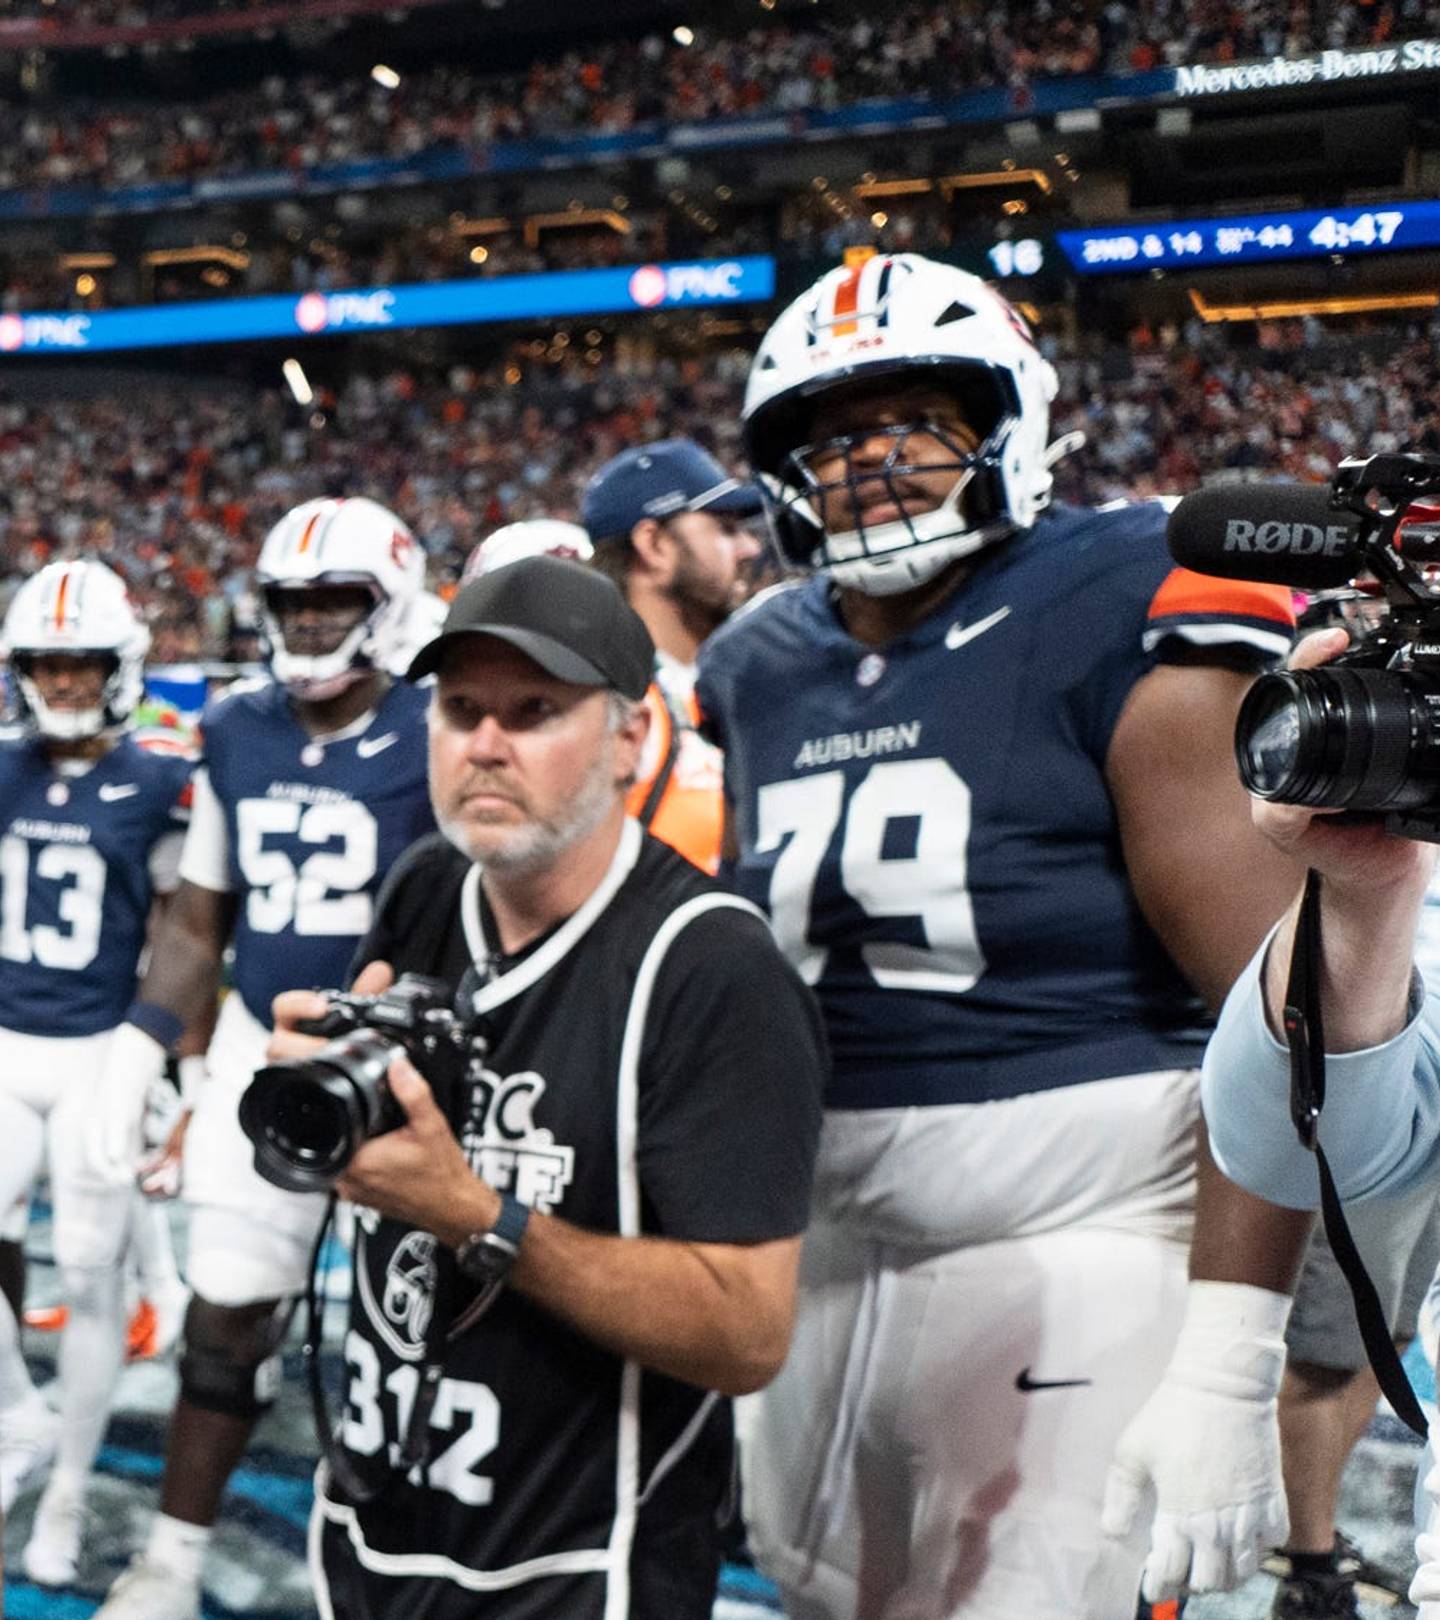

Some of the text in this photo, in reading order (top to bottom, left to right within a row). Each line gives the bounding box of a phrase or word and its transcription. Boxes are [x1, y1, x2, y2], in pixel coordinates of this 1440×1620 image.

[1175, 47, 1397, 96] Mercedes-Benz
[988, 239, 1044, 277] 16
[1082, 235, 1138, 263] 2ND
[1169, 231, 1203, 255] 14
[1309, 211, 1404, 249] 4:47
[1223, 519, 1347, 557] RØDE
[795, 721, 921, 769] AUBURN
[236, 797, 378, 935] 52
[756, 757, 987, 993] 79
[343, 1329, 501, 1506] 312
